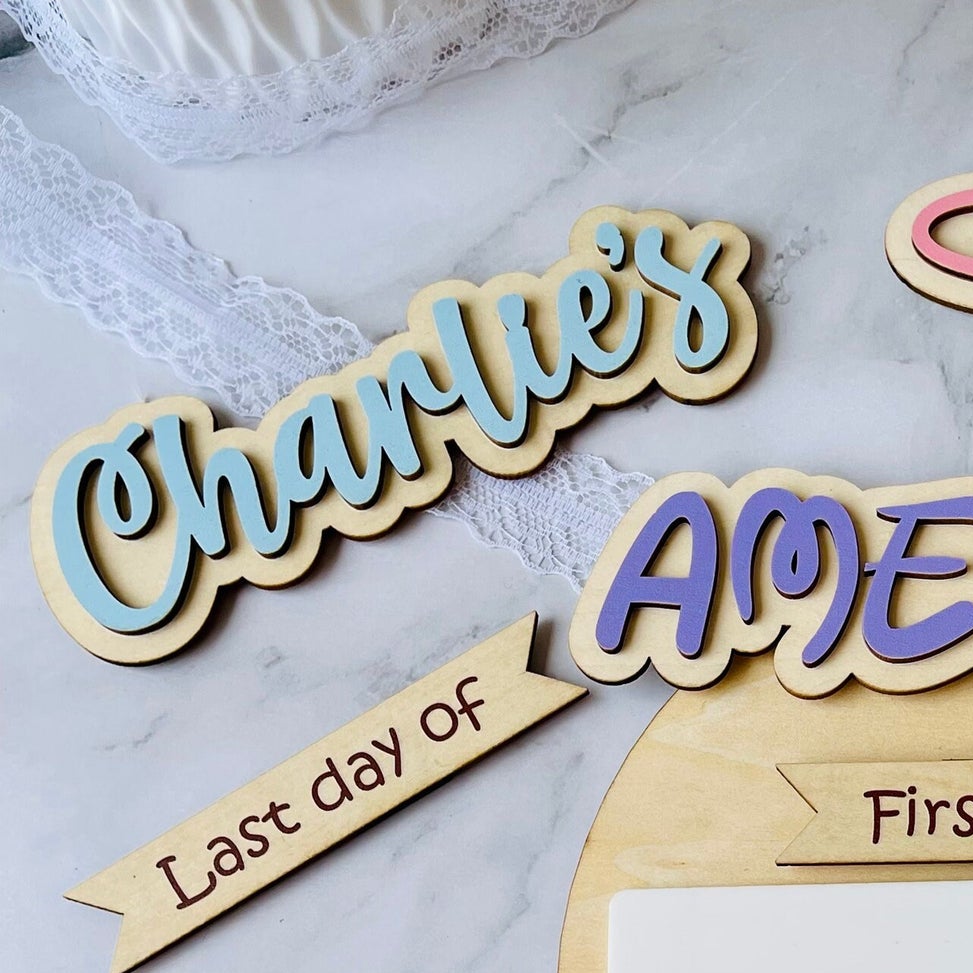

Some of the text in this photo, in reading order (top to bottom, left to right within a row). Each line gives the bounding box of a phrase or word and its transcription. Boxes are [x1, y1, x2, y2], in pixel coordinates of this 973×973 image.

[51, 221, 731, 636] Charlie's
[155, 800, 302, 910] Last
[310, 726, 402, 812] day
